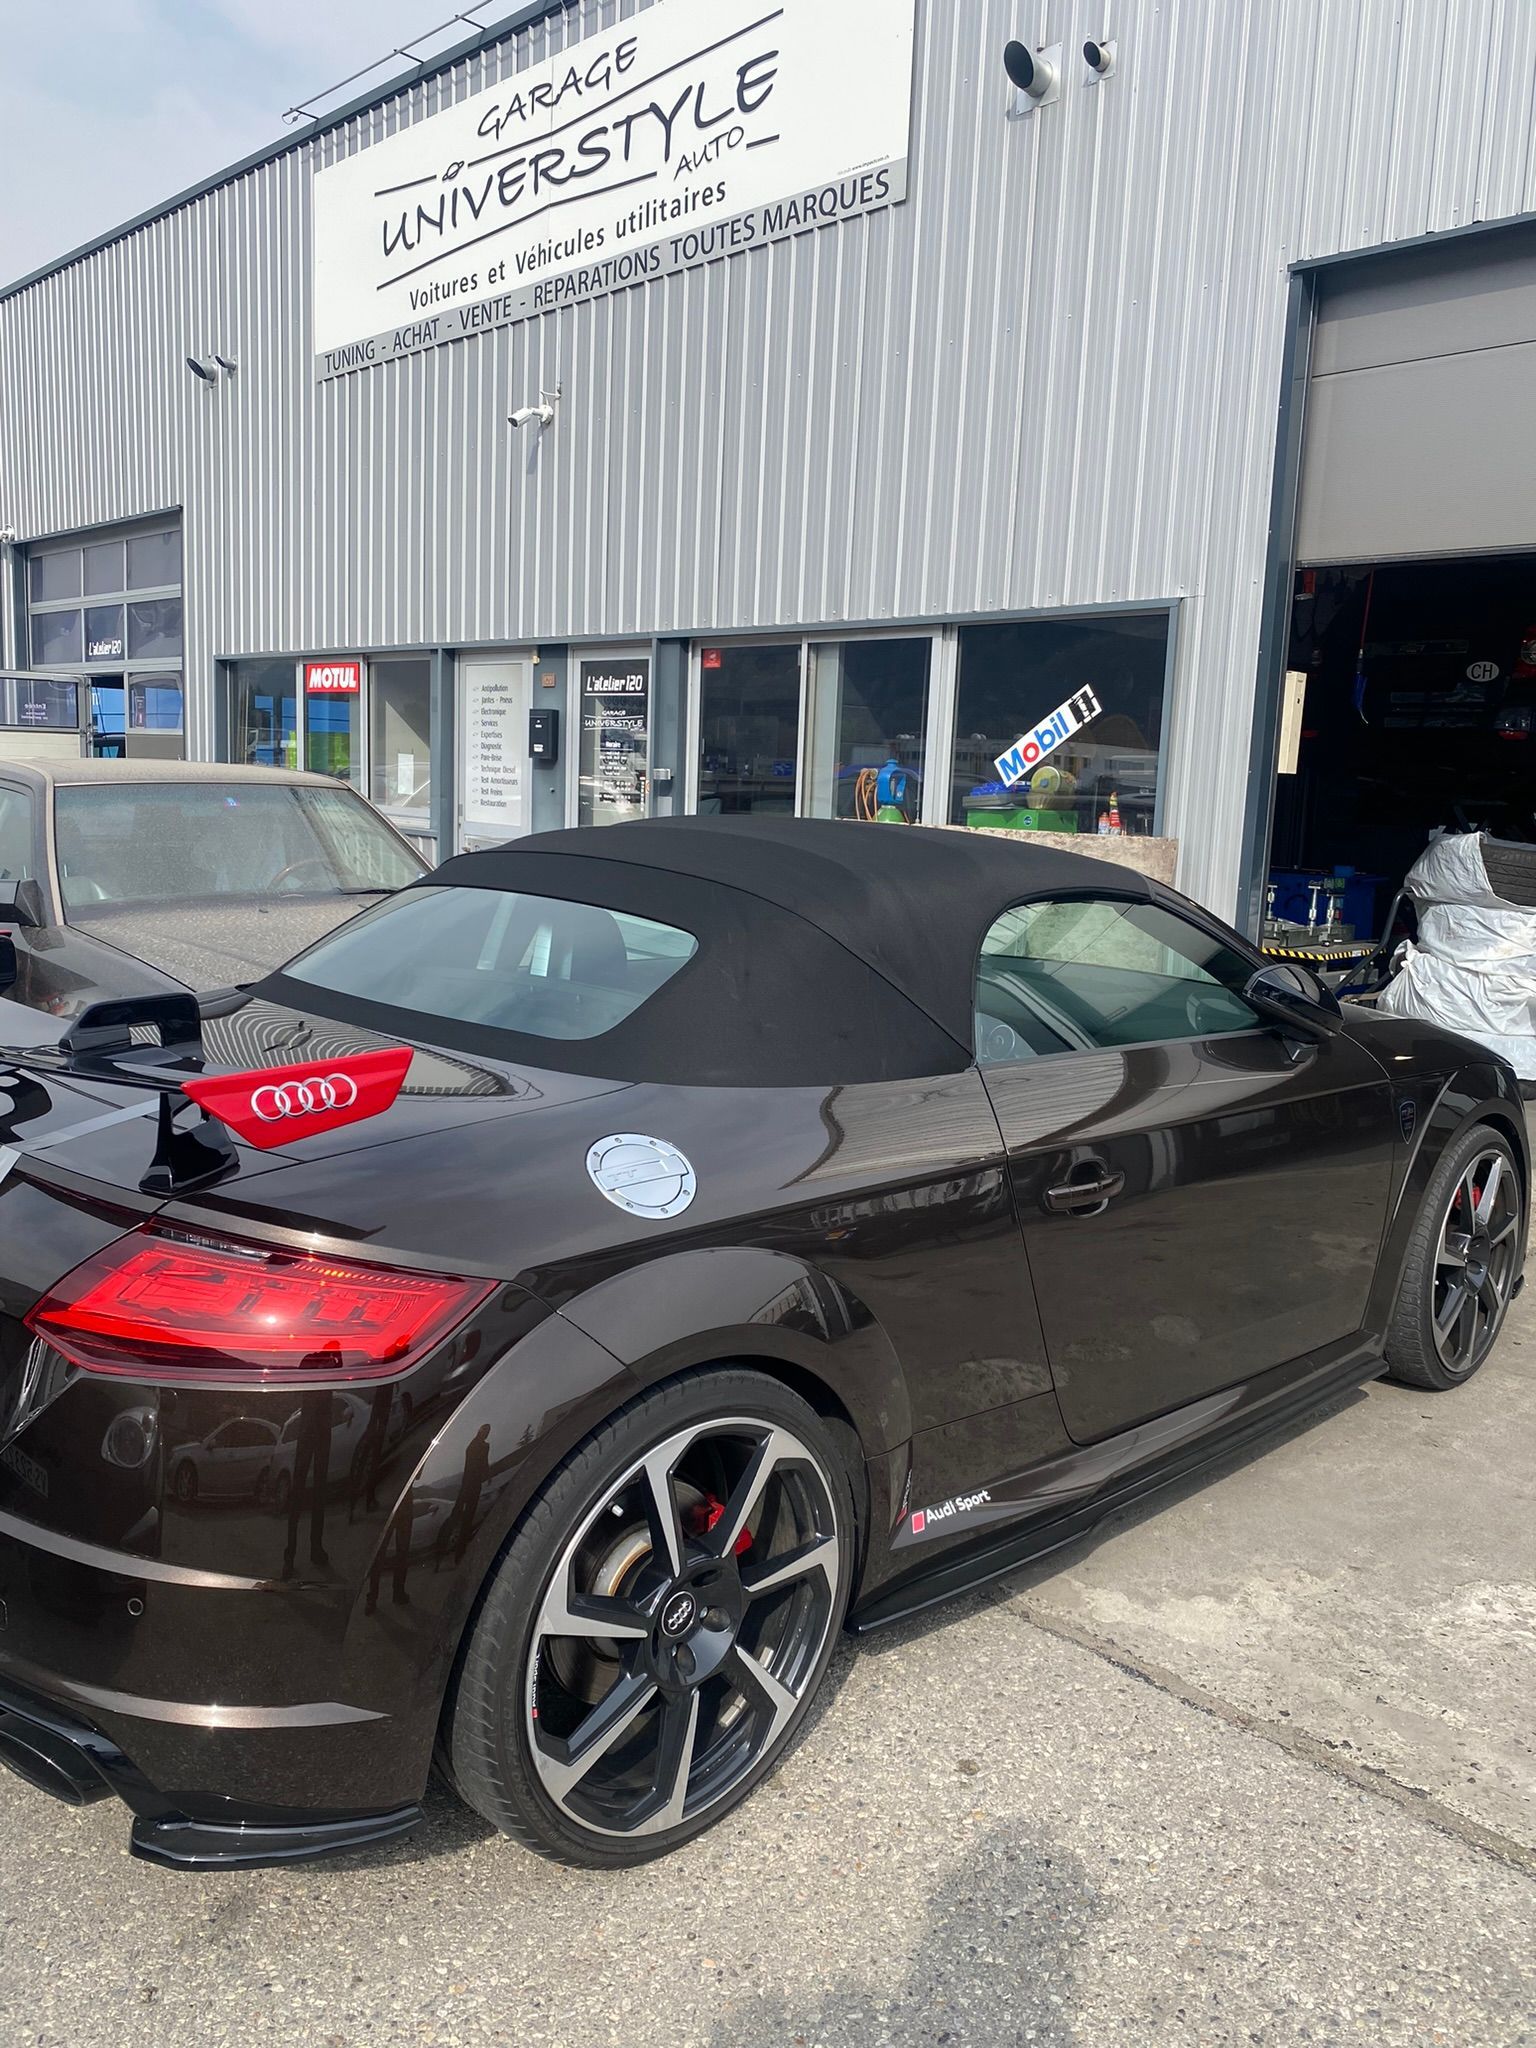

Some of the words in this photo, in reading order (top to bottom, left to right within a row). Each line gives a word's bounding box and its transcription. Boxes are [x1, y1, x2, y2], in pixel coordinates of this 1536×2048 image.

[477, 36, 638, 140] GARAGE
[383, 50, 780, 257] UNIVERSTYLE
[673, 126, 745, 181] AUTO
[324, 340, 375, 374] TUNING
[392, 318, 440, 353] ACHAT
[459, 295, 512, 331] VENTE
[534, 245, 661, 309] REPARATIONS
[670, 213, 756, 264] TOUTES
[763, 168, 890, 237] MARQUES
[409, 273, 478, 311] Voitures
[488, 261, 506, 284] et
[515, 227, 605, 275] Véhicules
[615, 181, 726, 239] utilitaires
[309, 666, 357, 689] MOTUL
[1470, 664, 1493, 680] CH
[584, 719, 643, 729] UNIVERSTYLE
[999, 711, 1070, 782] Mobil
[926, 1501, 957, 1524] Audi
[955, 1489, 991, 1512] Sport
